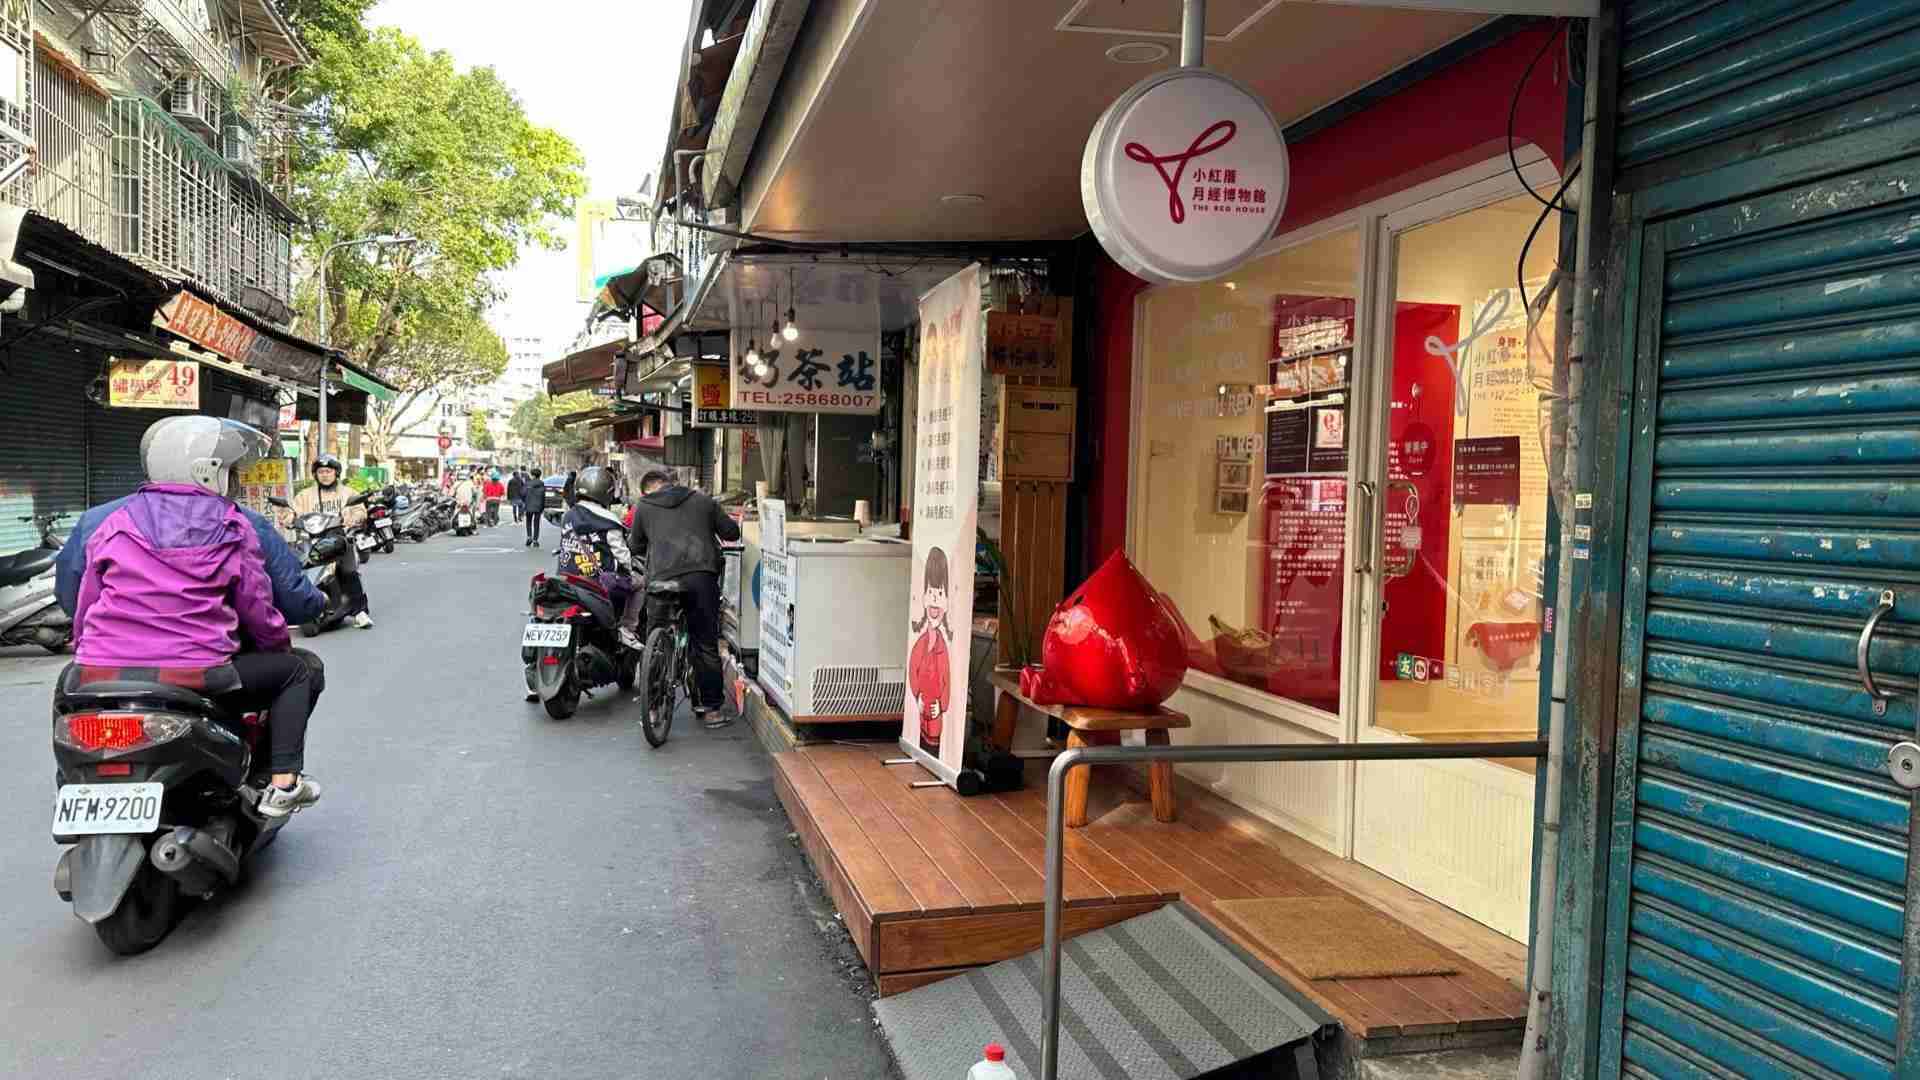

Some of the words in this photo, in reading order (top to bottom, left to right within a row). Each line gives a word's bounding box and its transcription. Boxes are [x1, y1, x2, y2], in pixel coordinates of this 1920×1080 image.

[1192, 186, 1267, 204] 月經博物館
[1193, 204, 1209, 212] THE
[1214, 205, 1232, 213] RED
[1235, 206, 1265, 214] HOUSE
[167, 366, 194, 387] 49
[738, 391, 875, 407] TEL:25868007
[524, 628, 569, 642] NEV-7259
[58, 795, 157, 823] NFM-9200
